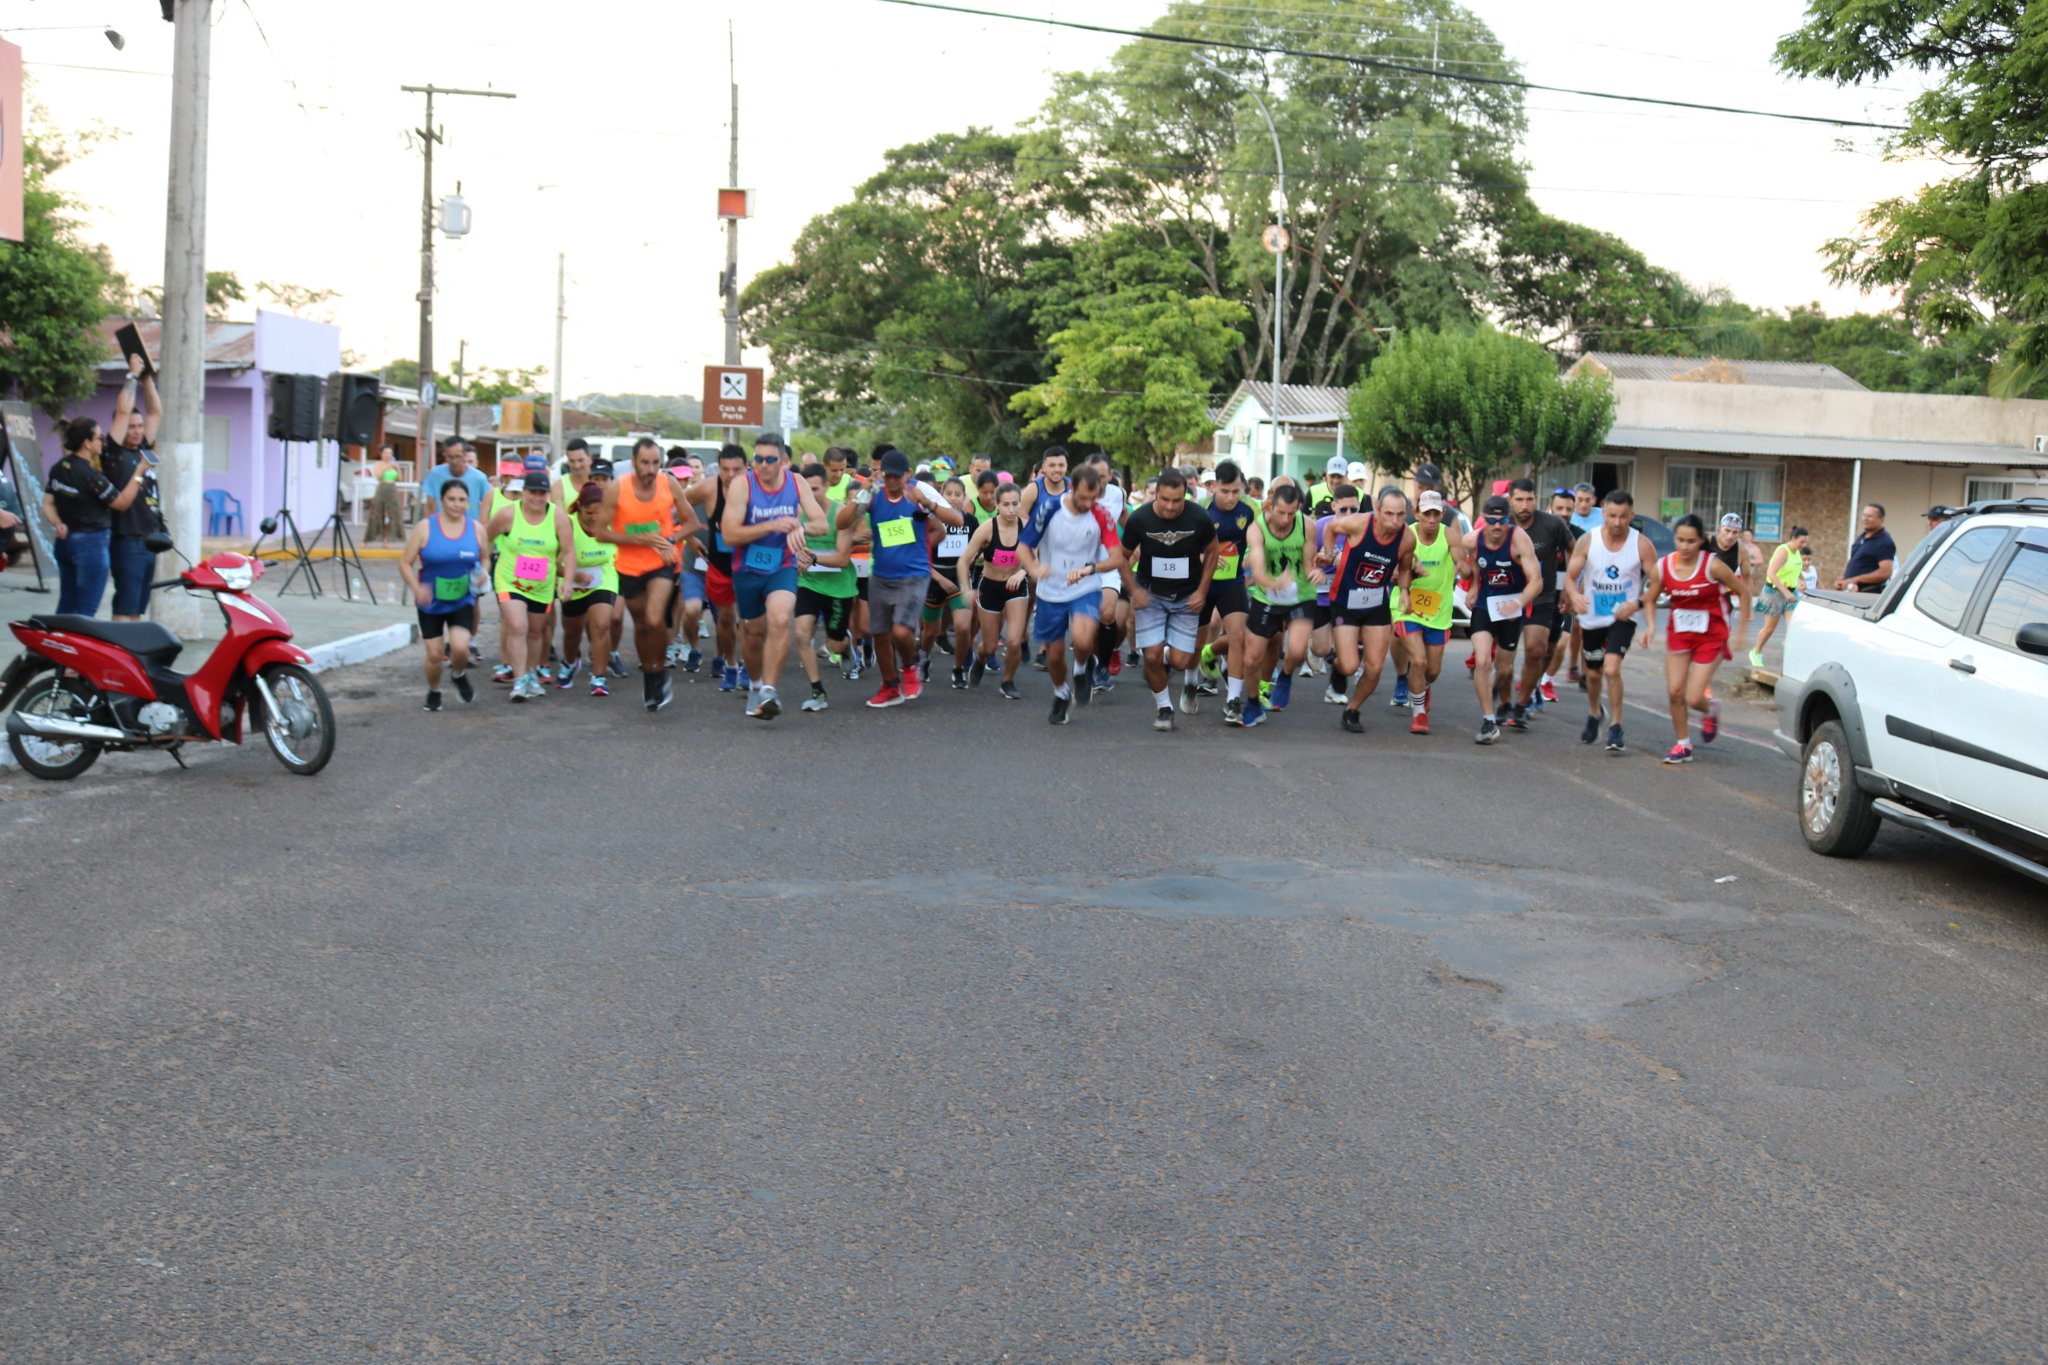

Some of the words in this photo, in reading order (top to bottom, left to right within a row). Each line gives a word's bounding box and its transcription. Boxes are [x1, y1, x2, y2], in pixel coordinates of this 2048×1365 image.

[887, 525, 905, 537] 156
[942, 522, 970, 535] Yoga
[944, 540, 962, 549] 110
[754, 551, 772, 565] 83
[1000, 555, 1015, 564] 31
[522, 562, 541, 572] 142
[1163, 563, 1176, 571] 18
[445, 582, 461, 592] 72
[1362, 595, 1369, 605] 9
[1416, 593, 1433, 607] 26
